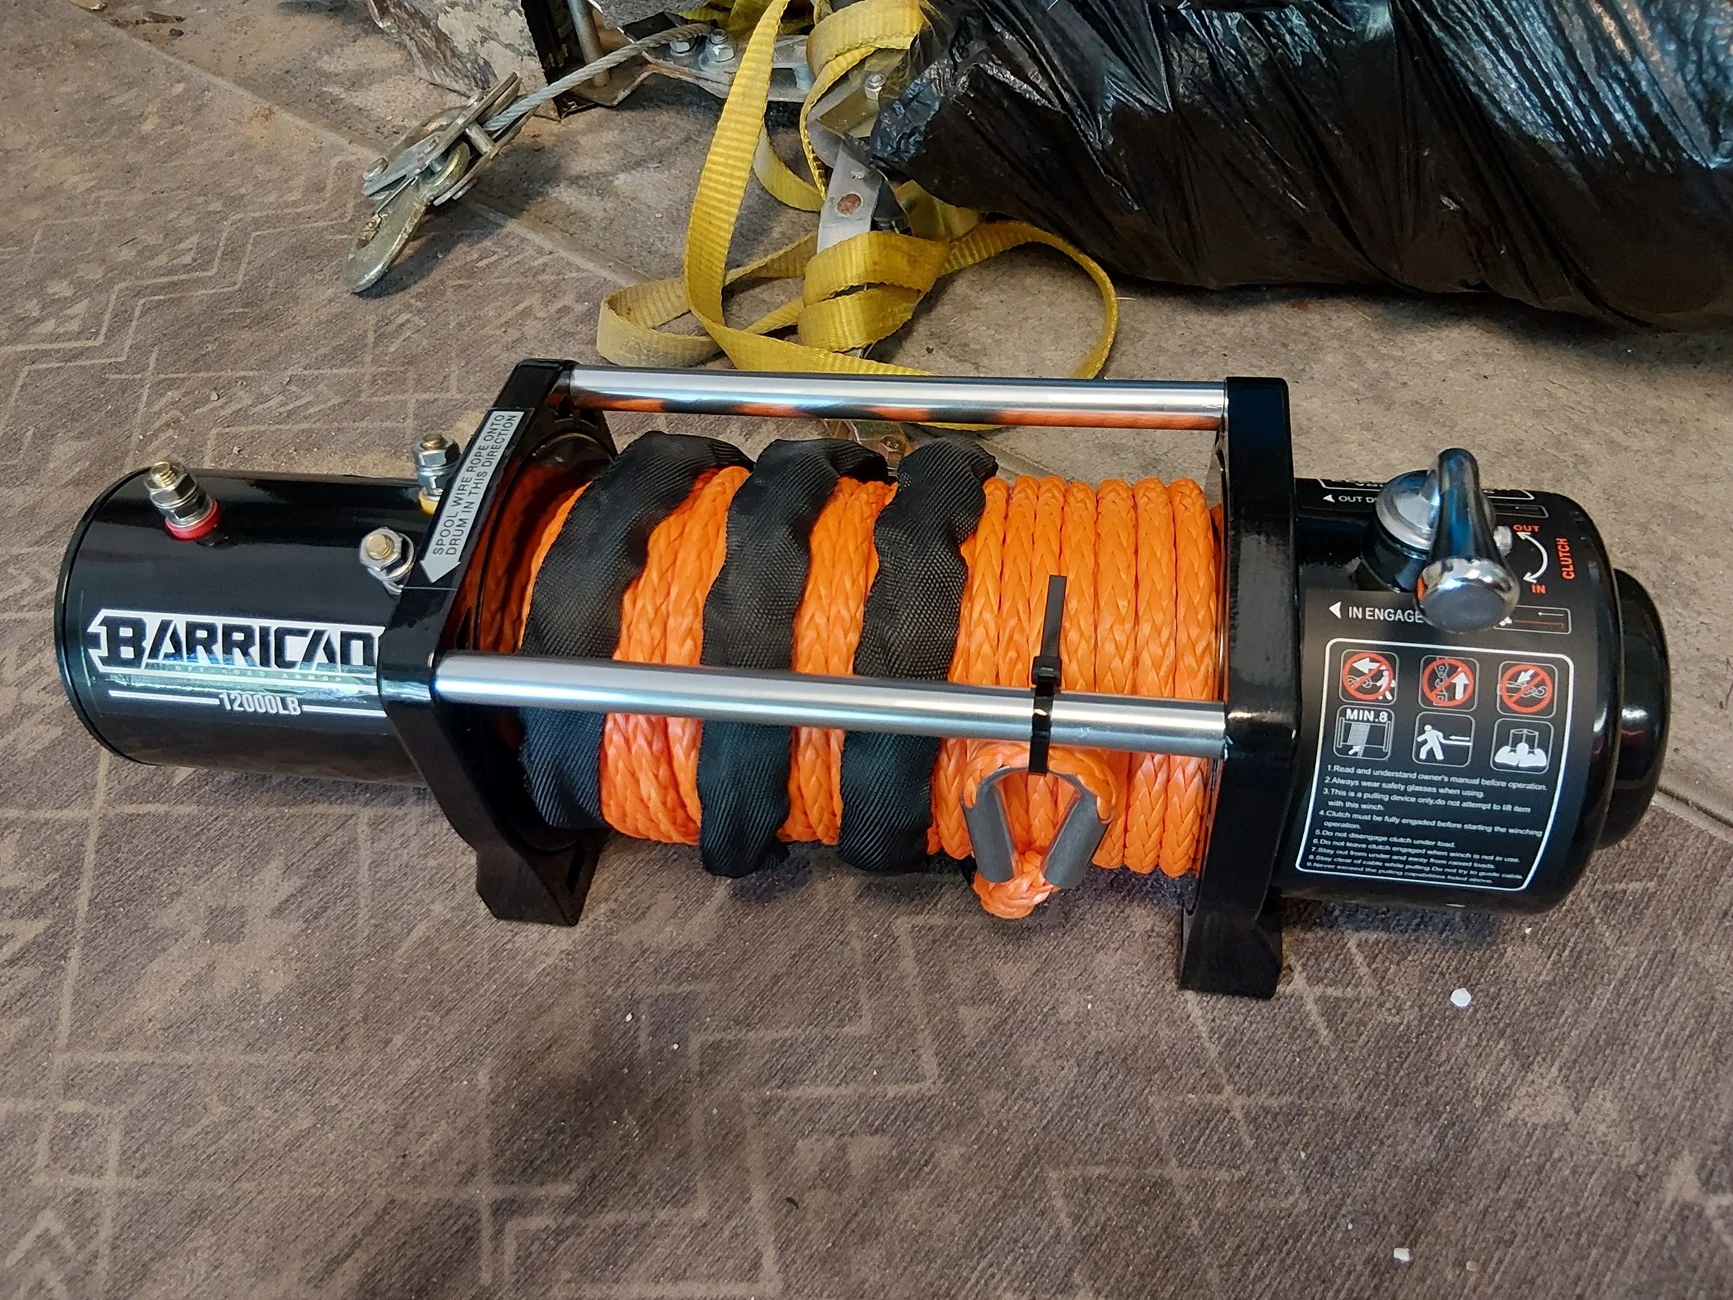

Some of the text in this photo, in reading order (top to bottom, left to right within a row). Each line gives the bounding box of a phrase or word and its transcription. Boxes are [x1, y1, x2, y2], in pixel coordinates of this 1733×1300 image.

[433, 414, 505, 555] SPOOL WIRE ROPE ONTO
[446, 414, 518, 556] DRUM IN THIS DIRECTION
[1513, 524, 1540, 532] OUT
[1556, 538, 1575, 580] CLUTCH
[1532, 584, 1546, 594] IN
[1348, 606, 1362, 619] IN
[100, 615, 376, 673] BARRICAD
[219, 692, 302, 716] 12000LB
[1346, 708, 1388, 723] MIN.8
[1356, 767, 1371, 775] and
[1373, 768, 1416, 779] understand
[1418, 773, 1448, 781] owner's
[1450, 776, 1480, 785] manual
[1481, 778, 1506, 787] before
[1508, 782, 1547, 791] operation.
[1382, 782, 1405, 791] safety
[1407, 784, 1436, 793] glasses
[1439, 787, 1460, 795] when
[1364, 792, 1389, 801] pulling
[1462, 801, 1491, 810] attempt
[1324, 821, 1361, 829] operation.
[1384, 816, 1400, 824] fully
[1464, 823, 1492, 832] starting
[1508, 828, 1542, 837] winching
[1348, 833, 1388, 841] disengage
